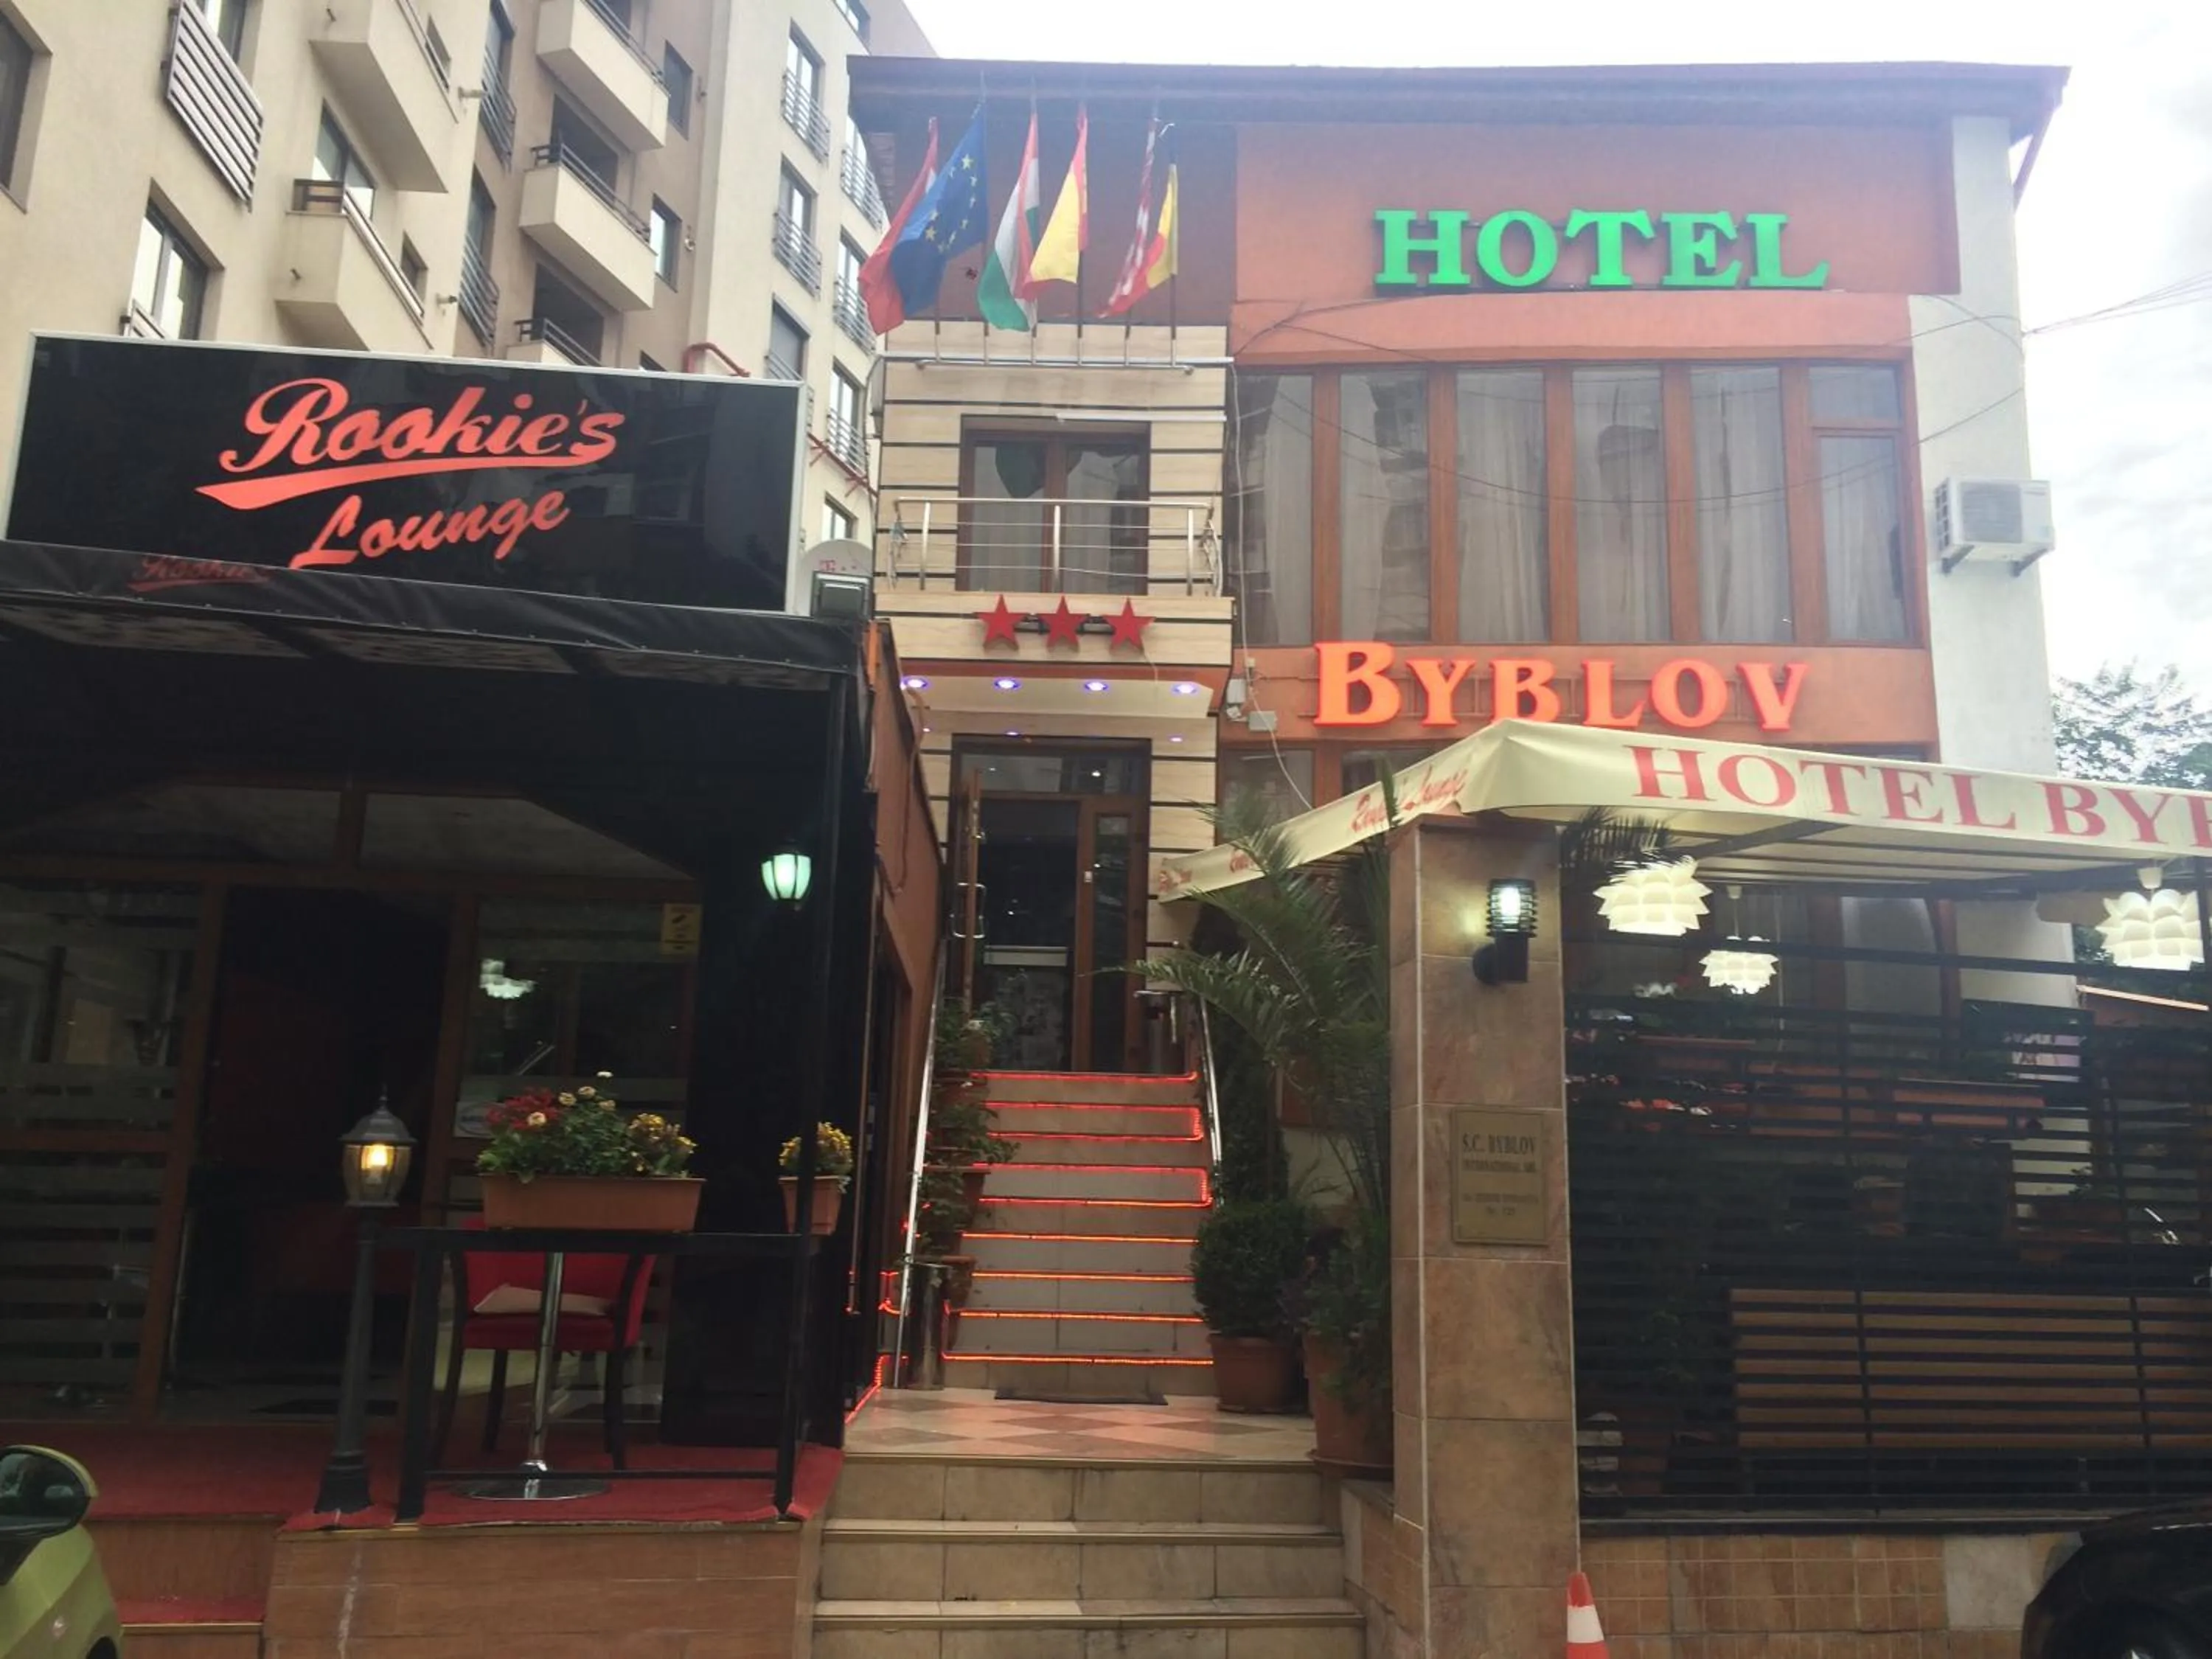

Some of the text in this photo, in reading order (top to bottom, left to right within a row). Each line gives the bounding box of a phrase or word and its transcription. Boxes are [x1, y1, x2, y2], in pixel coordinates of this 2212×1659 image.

[1373, 208, 1830, 289] HOTEL
[218, 377, 625, 473] Rookie's
[289, 488, 570, 571] Lounge
[1313, 641, 1809, 730] BYBLOV
[1622, 744, 2017, 832] HOTEL
